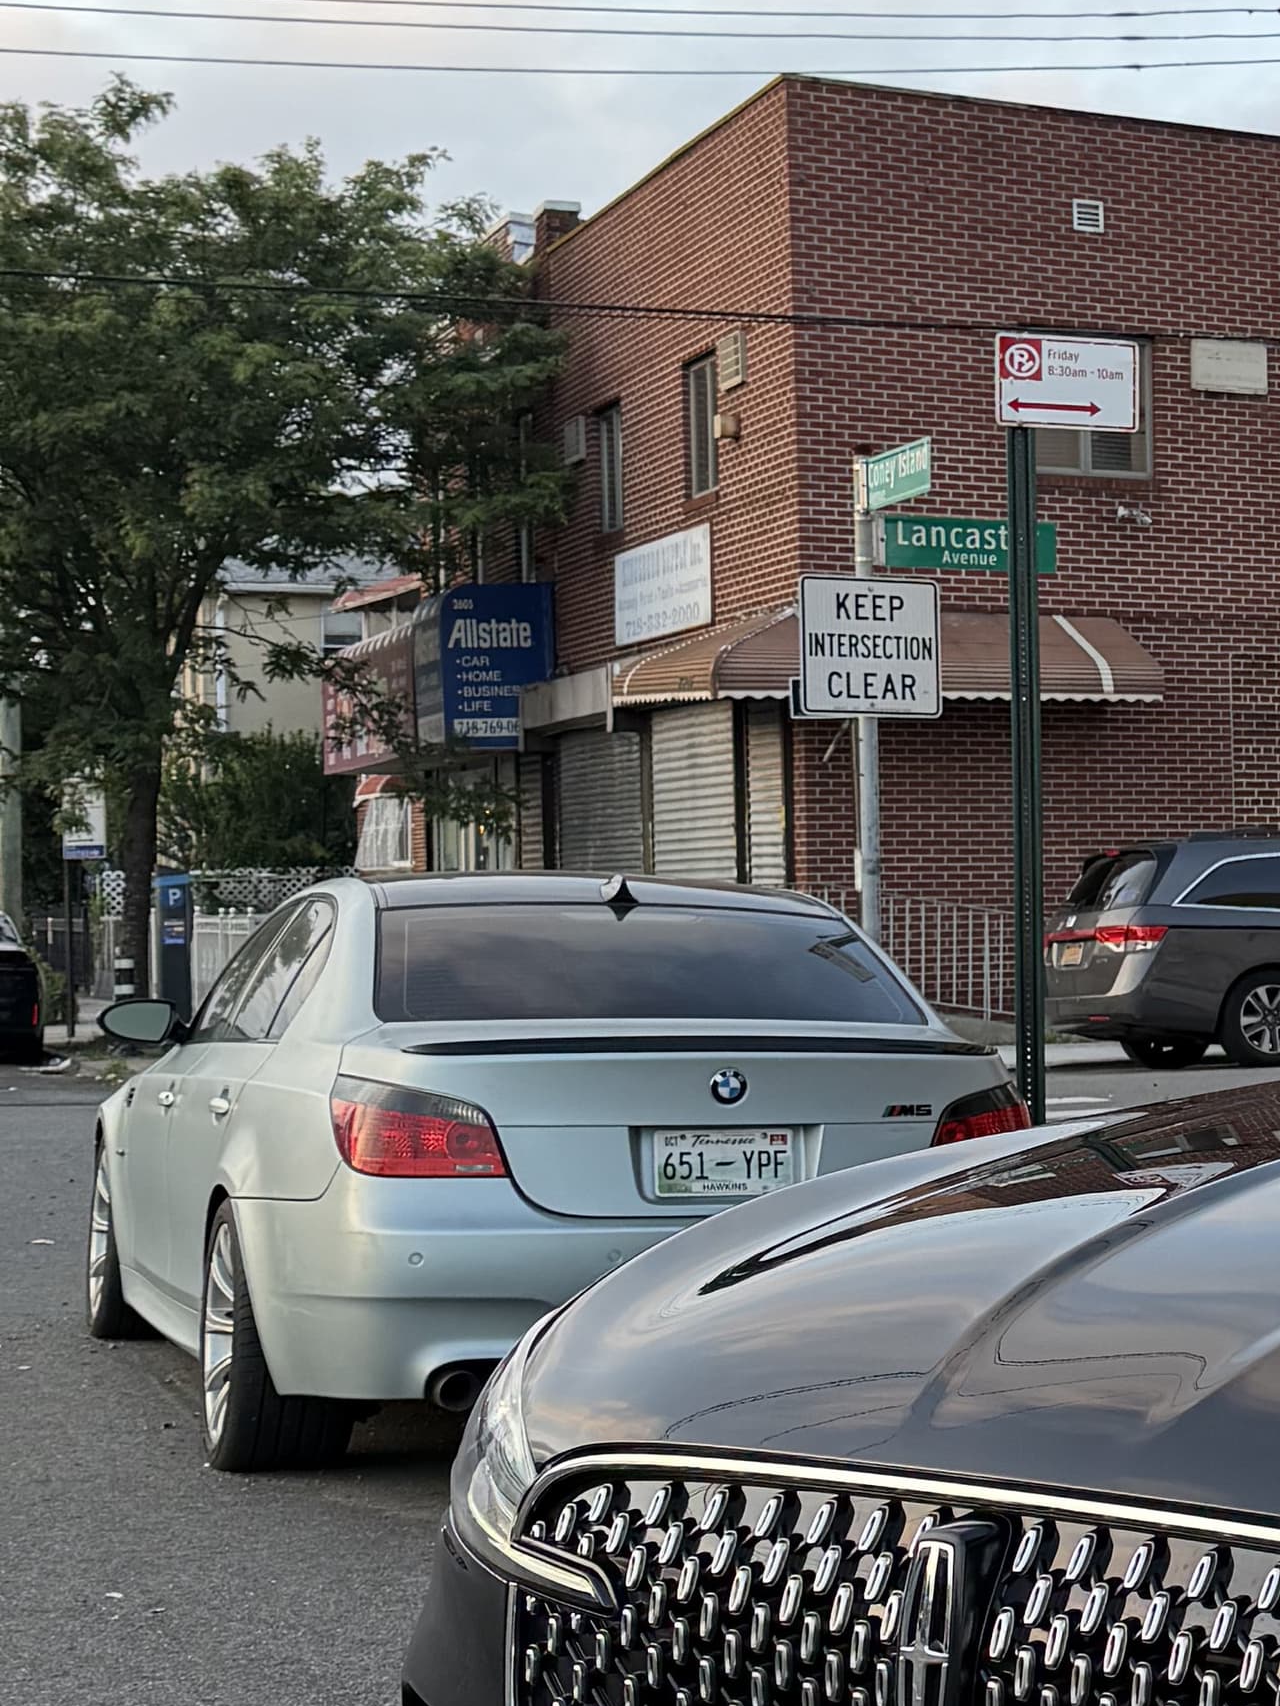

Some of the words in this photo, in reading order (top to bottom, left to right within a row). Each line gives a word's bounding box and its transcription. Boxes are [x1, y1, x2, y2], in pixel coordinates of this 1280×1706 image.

[1048, 349, 1080, 364] Friday
[1048, 365, 1088, 378] 8:30am
[1097, 368, 1124, 380] 10am
[897, 520, 1008, 551] Lancast
[942, 550, 998, 566] Avenue
[836, 592, 904, 622] KEEP
[448, 617, 533, 649] Allstate
[808, 632, 933, 661] INTERSECTION
[462, 656, 490, 667] CAR
[462, 670, 502, 682] HOME
[828, 671, 916, 701] CLEAR
[464, 700, 493, 712] LIFE
[690, 1134, 756, 1148] Tennessee
[702, 1182, 749, 1192] HAWKINS
